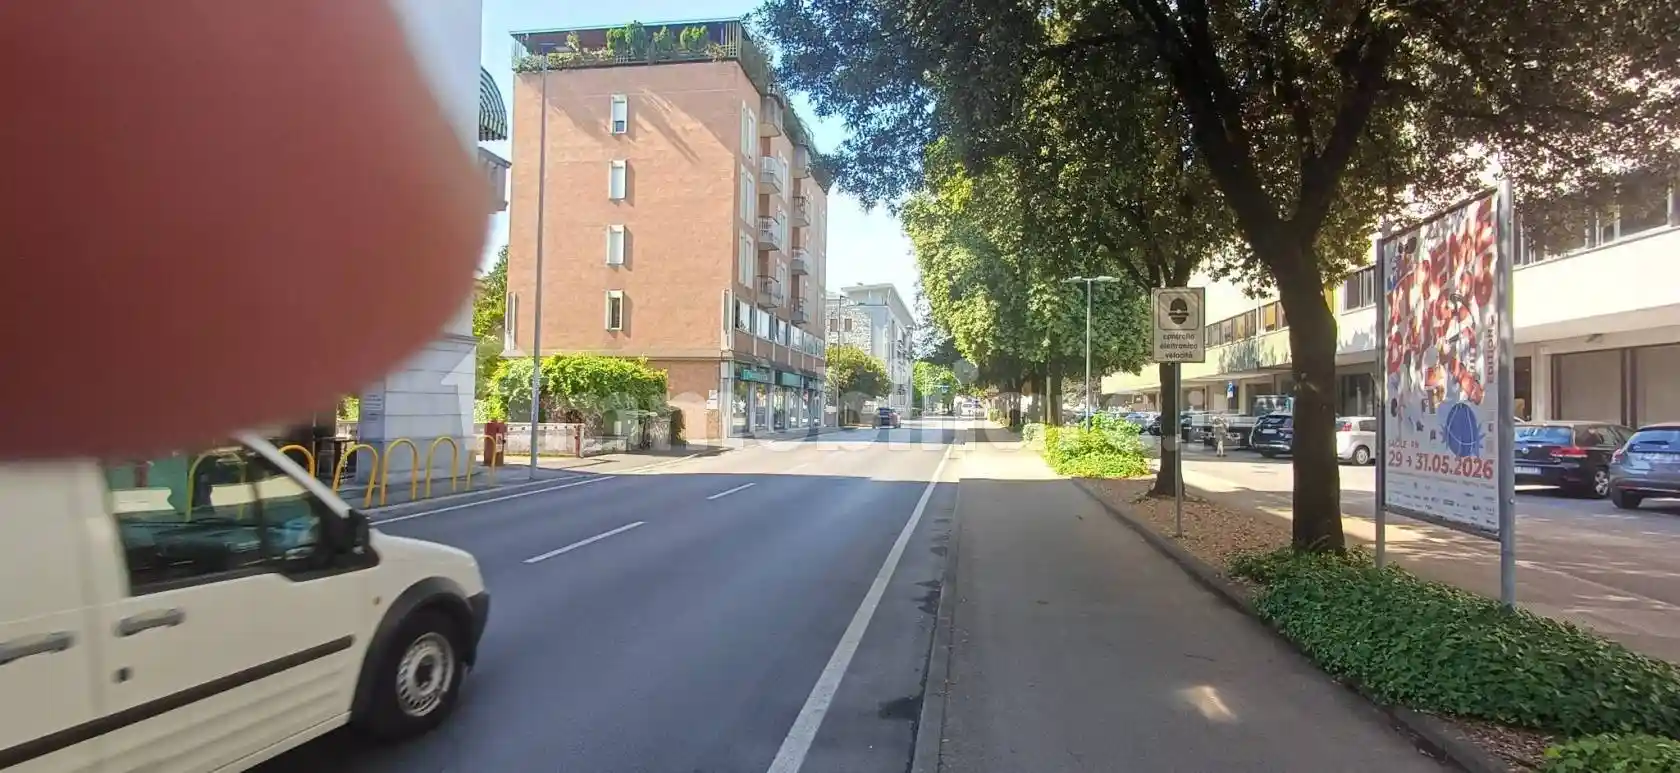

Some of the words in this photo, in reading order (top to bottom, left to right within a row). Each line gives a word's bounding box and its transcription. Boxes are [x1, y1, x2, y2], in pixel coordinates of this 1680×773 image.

[1163, 331, 1195, 340] controllo
[1160, 342, 1198, 350] elettronico
[1165, 351, 1193, 359] velocità
[1388, 450, 1403, 467] 29
[1415, 452, 1494, 480] 31.05.2026
